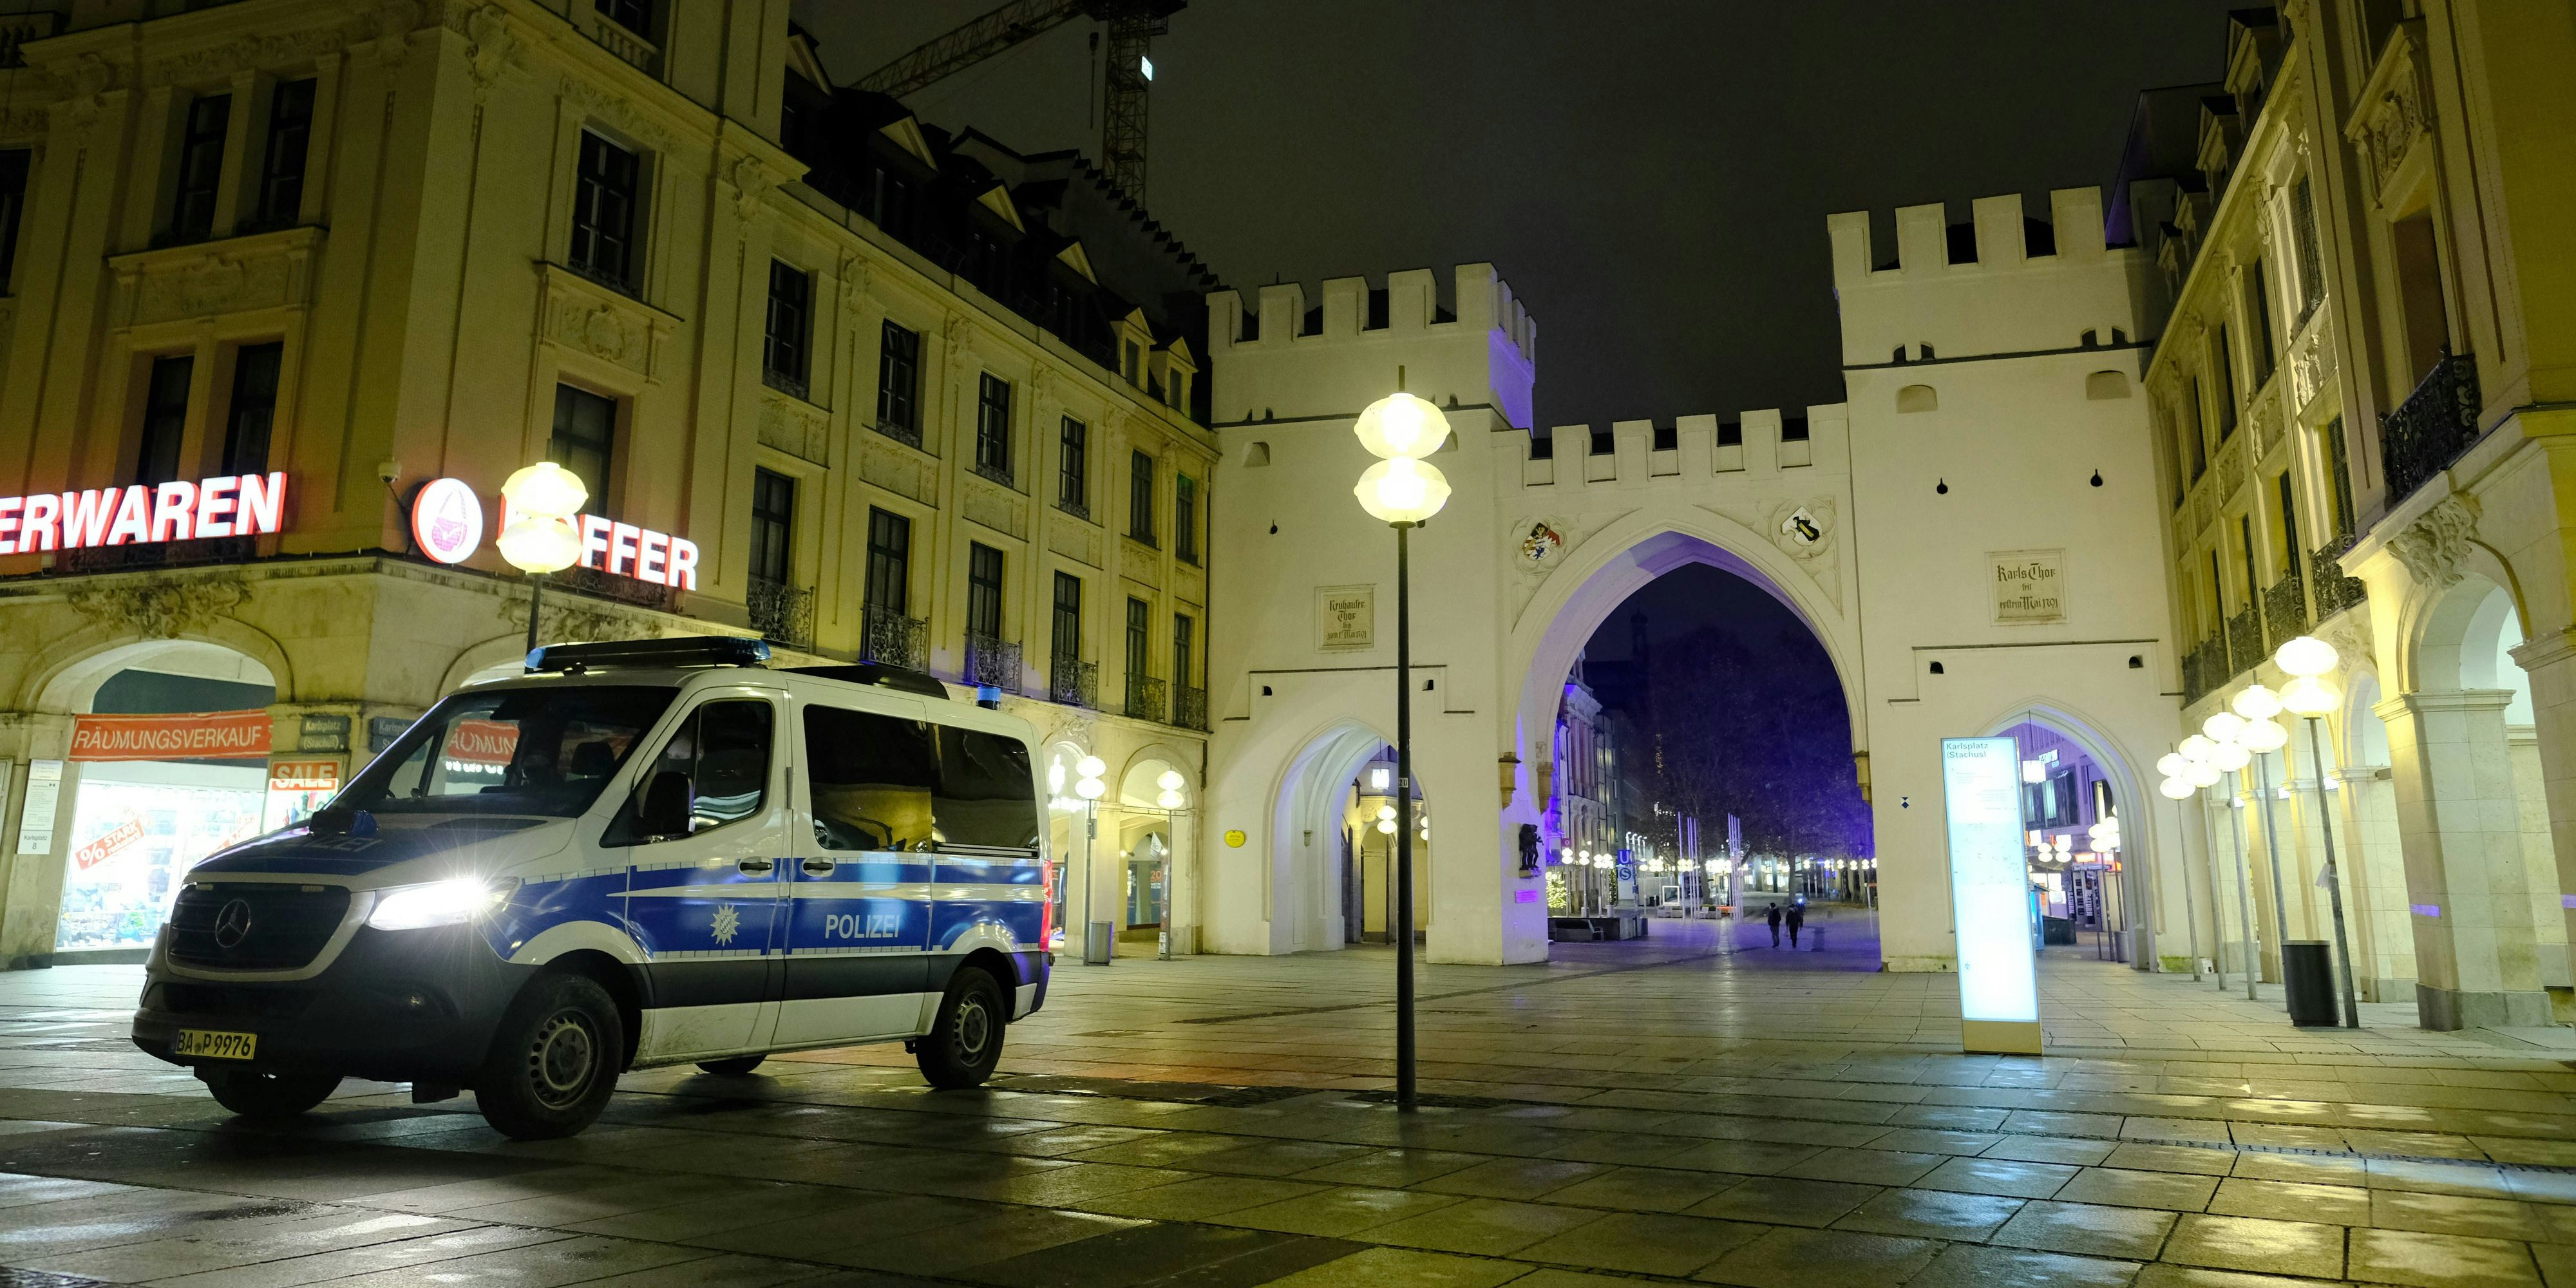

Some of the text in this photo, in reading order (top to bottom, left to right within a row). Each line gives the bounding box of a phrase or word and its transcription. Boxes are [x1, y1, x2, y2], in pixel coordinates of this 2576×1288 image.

[1997, 563, 2056, 582] Karls Thor
[2020, 596, 2041, 610] Mai
[305, 720, 340, 733] Karlsplatz
[74, 725, 262, 750] RÄUMUNGSVERKAUF
[1946, 742, 1989, 751] Karlsplatz
[276, 765, 334, 789] SALE
[103, 821, 138, 848] STARK
[1620, 851, 1629, 864] U
[1621, 869, 1630, 879] S
[825, 914, 900, 939] POLIZEI
[176, 1032, 251, 1056] BA P 9976
